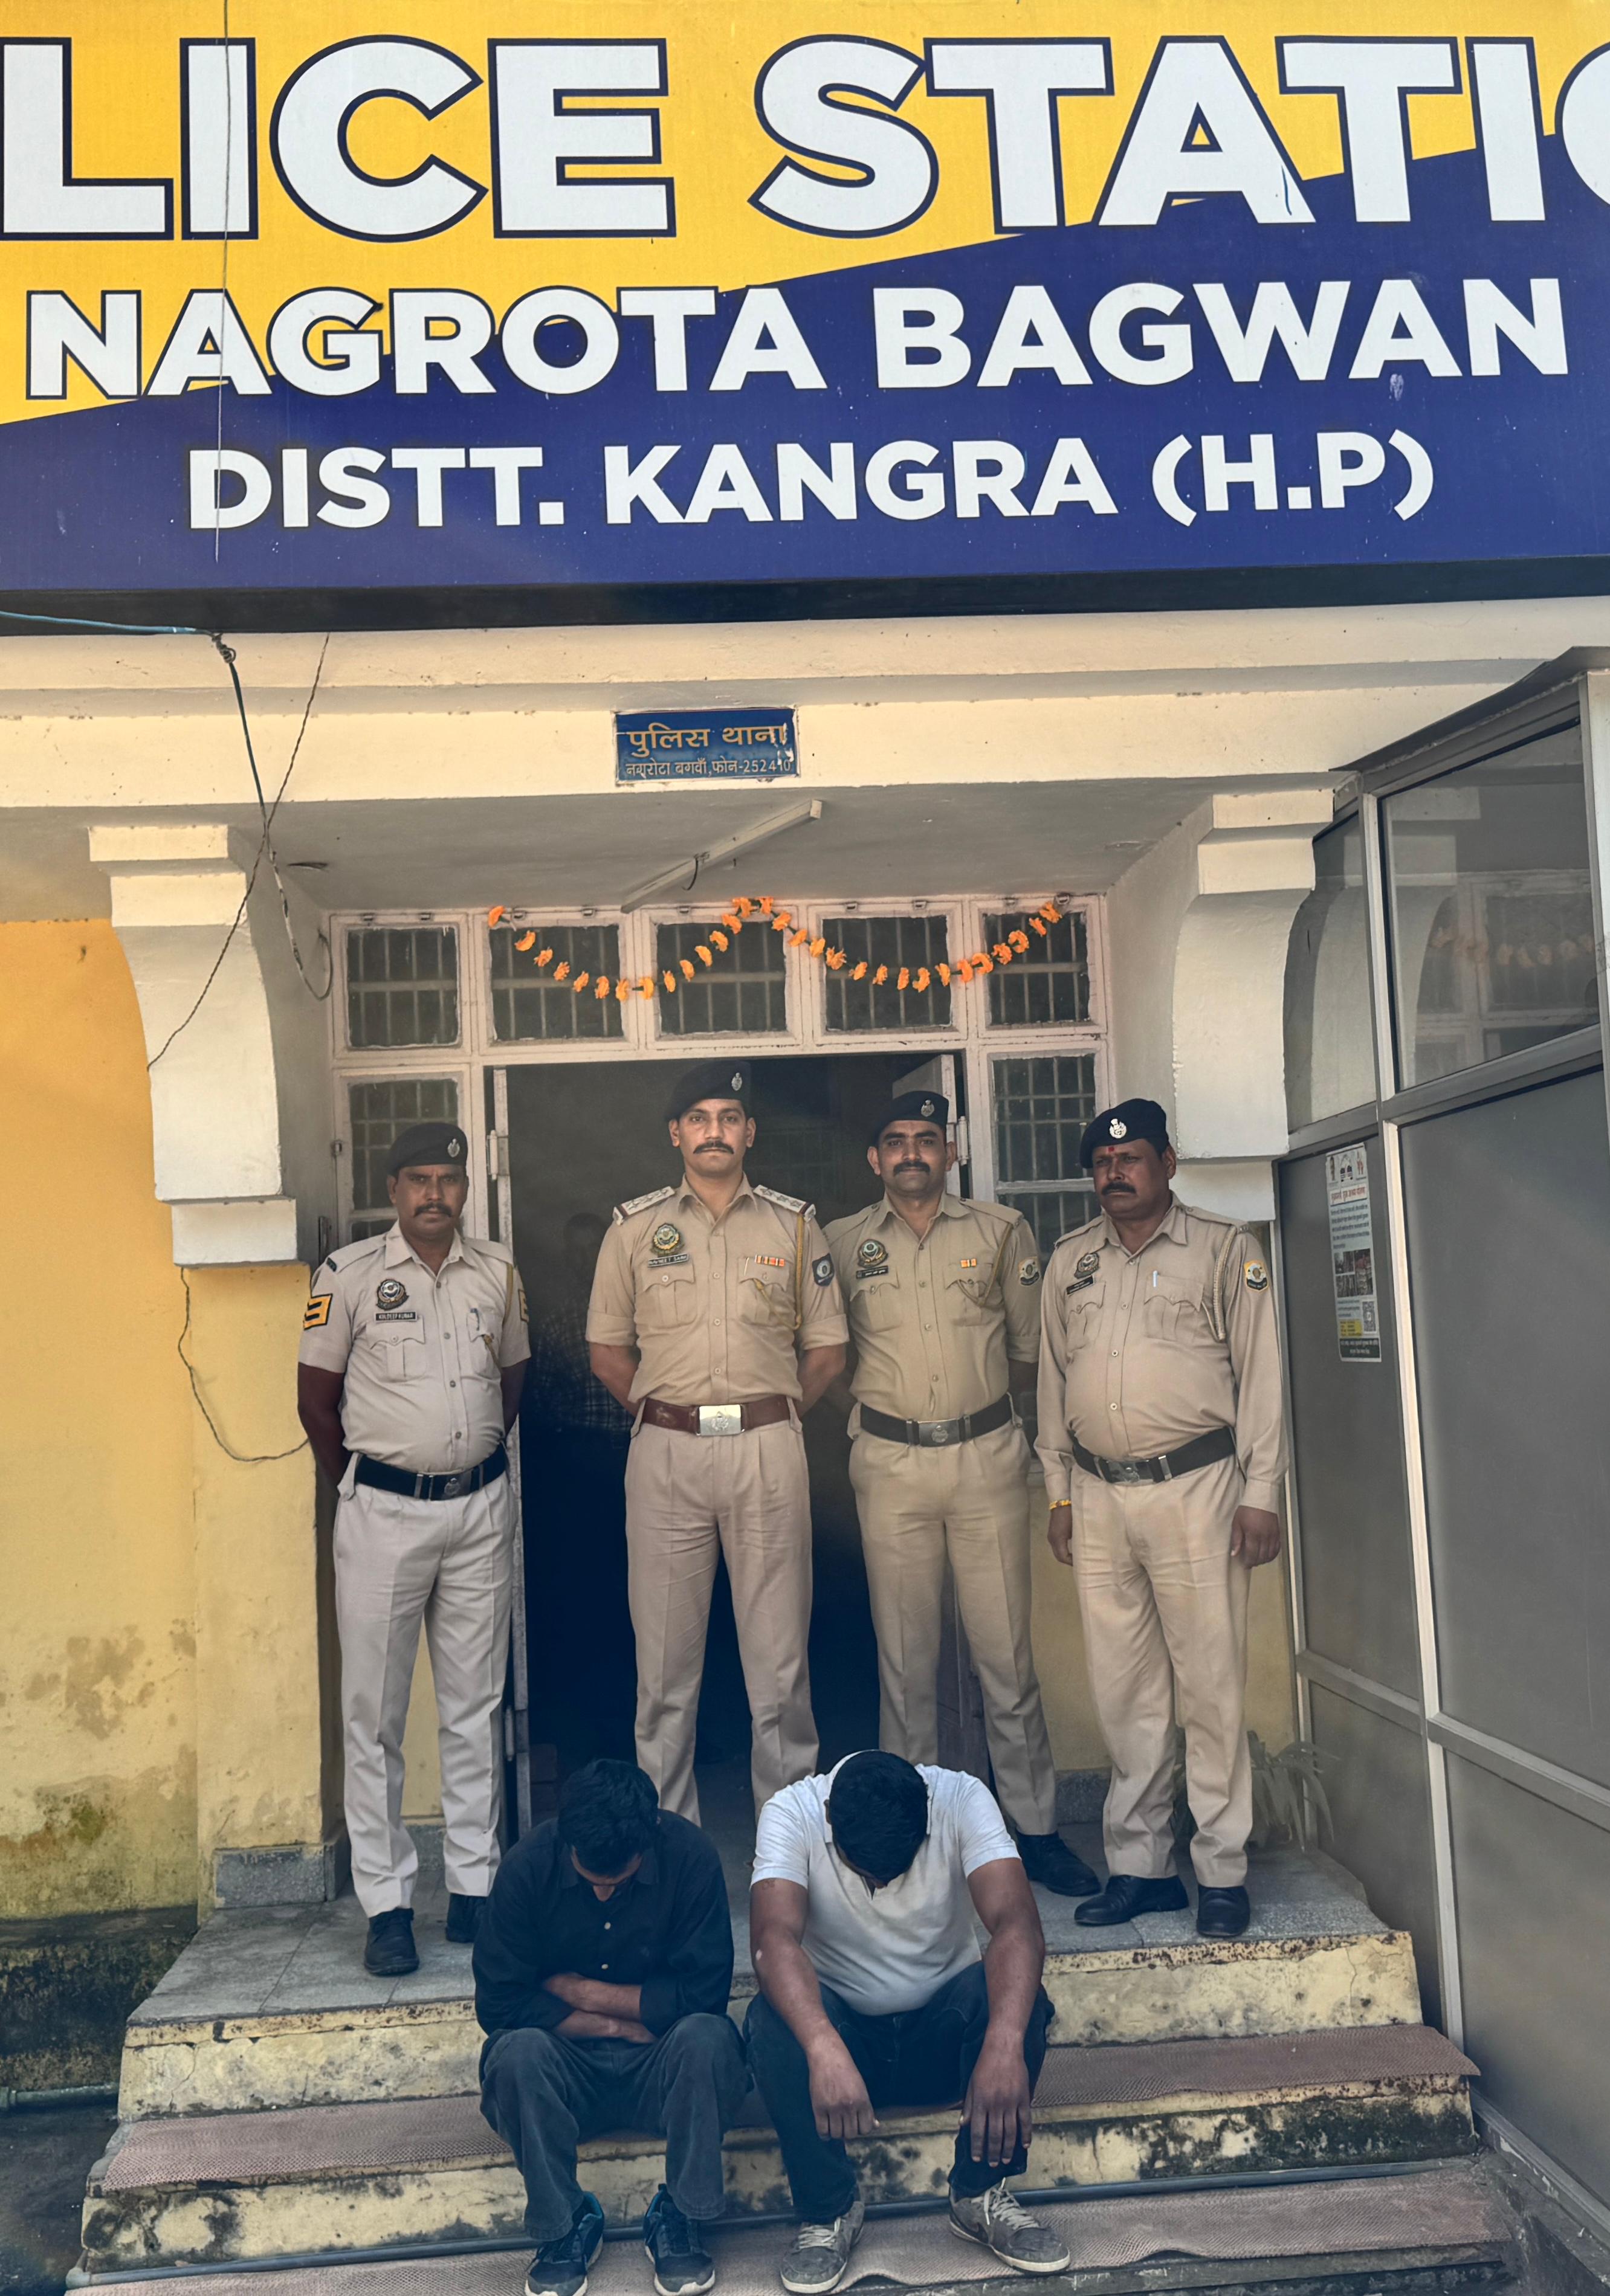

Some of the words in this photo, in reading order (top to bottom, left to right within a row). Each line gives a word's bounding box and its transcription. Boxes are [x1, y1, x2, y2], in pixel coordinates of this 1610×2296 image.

[748, 34, 1610, 238] STATI
[27, 286, 827, 400] NAGROTA
[873, 278, 1569, 389] BAGWAN
[189, 447, 564, 529] DISTT.
[604, 437, 1118, 524] KANGRA
[1152, 429, 1434, 527] (H.P)
[627, 723, 710, 757] पुलिस
[722, 726, 786, 746] थाना
